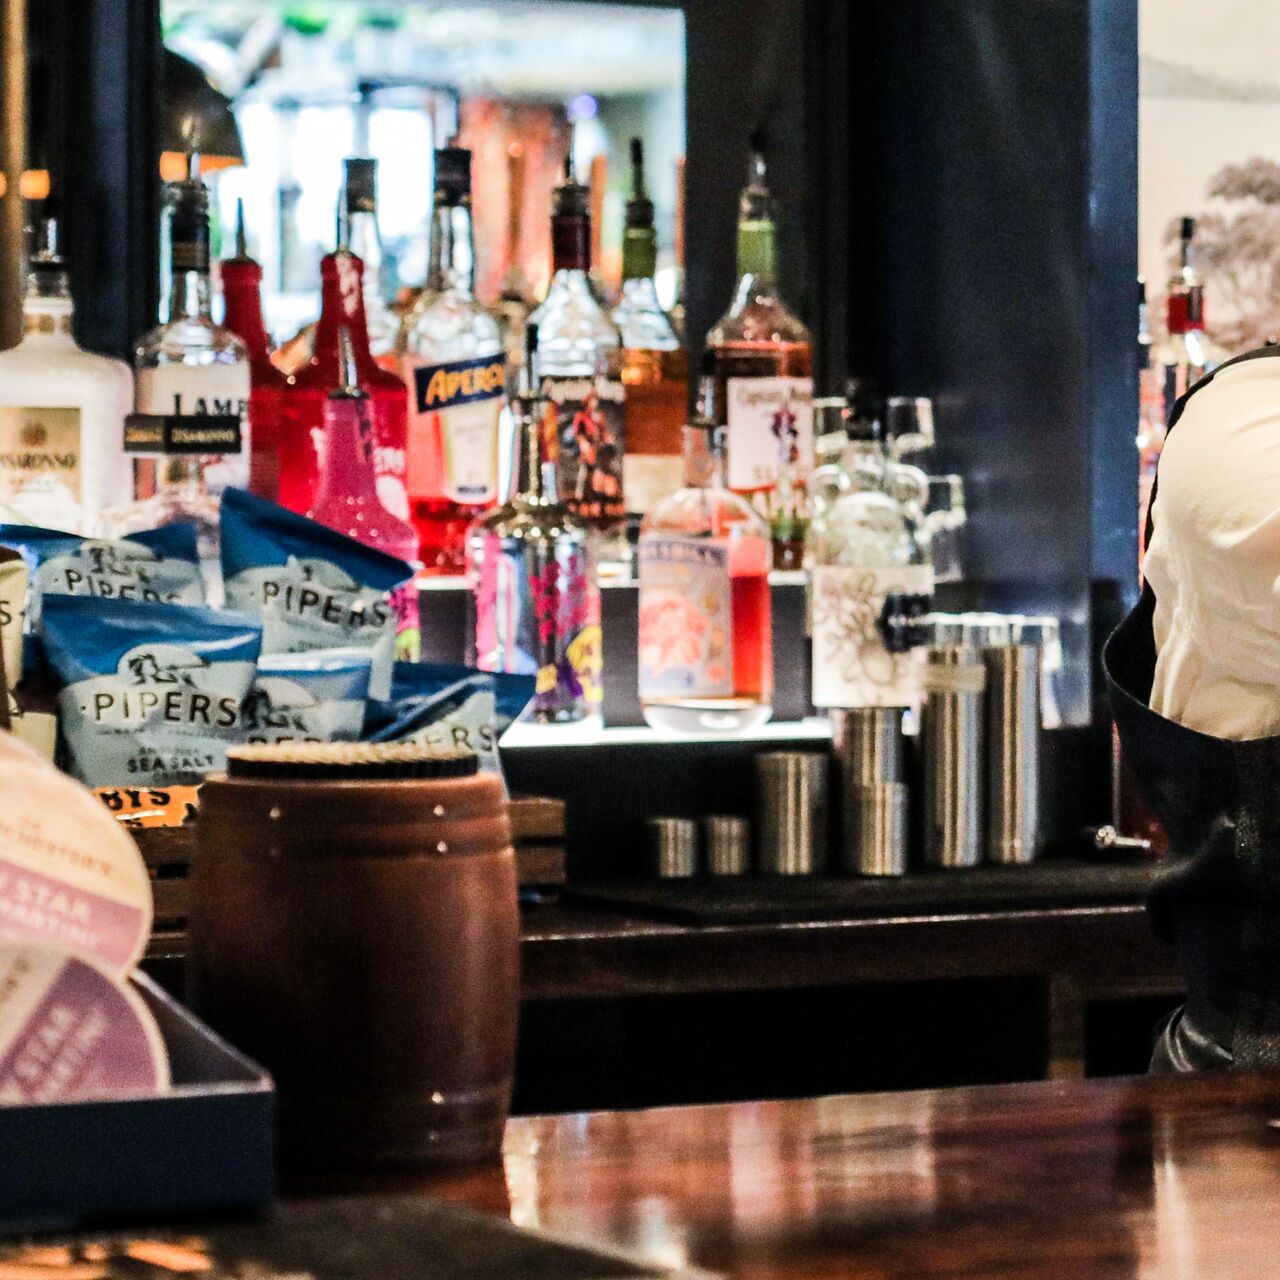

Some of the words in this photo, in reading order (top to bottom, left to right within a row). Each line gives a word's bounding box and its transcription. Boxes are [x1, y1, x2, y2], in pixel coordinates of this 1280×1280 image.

[64, 569, 183, 602] PIPER
[94, 690, 238, 727] PIPERS
[127, 756, 166, 773] SEA
[170, 754, 214, 770] SALT
